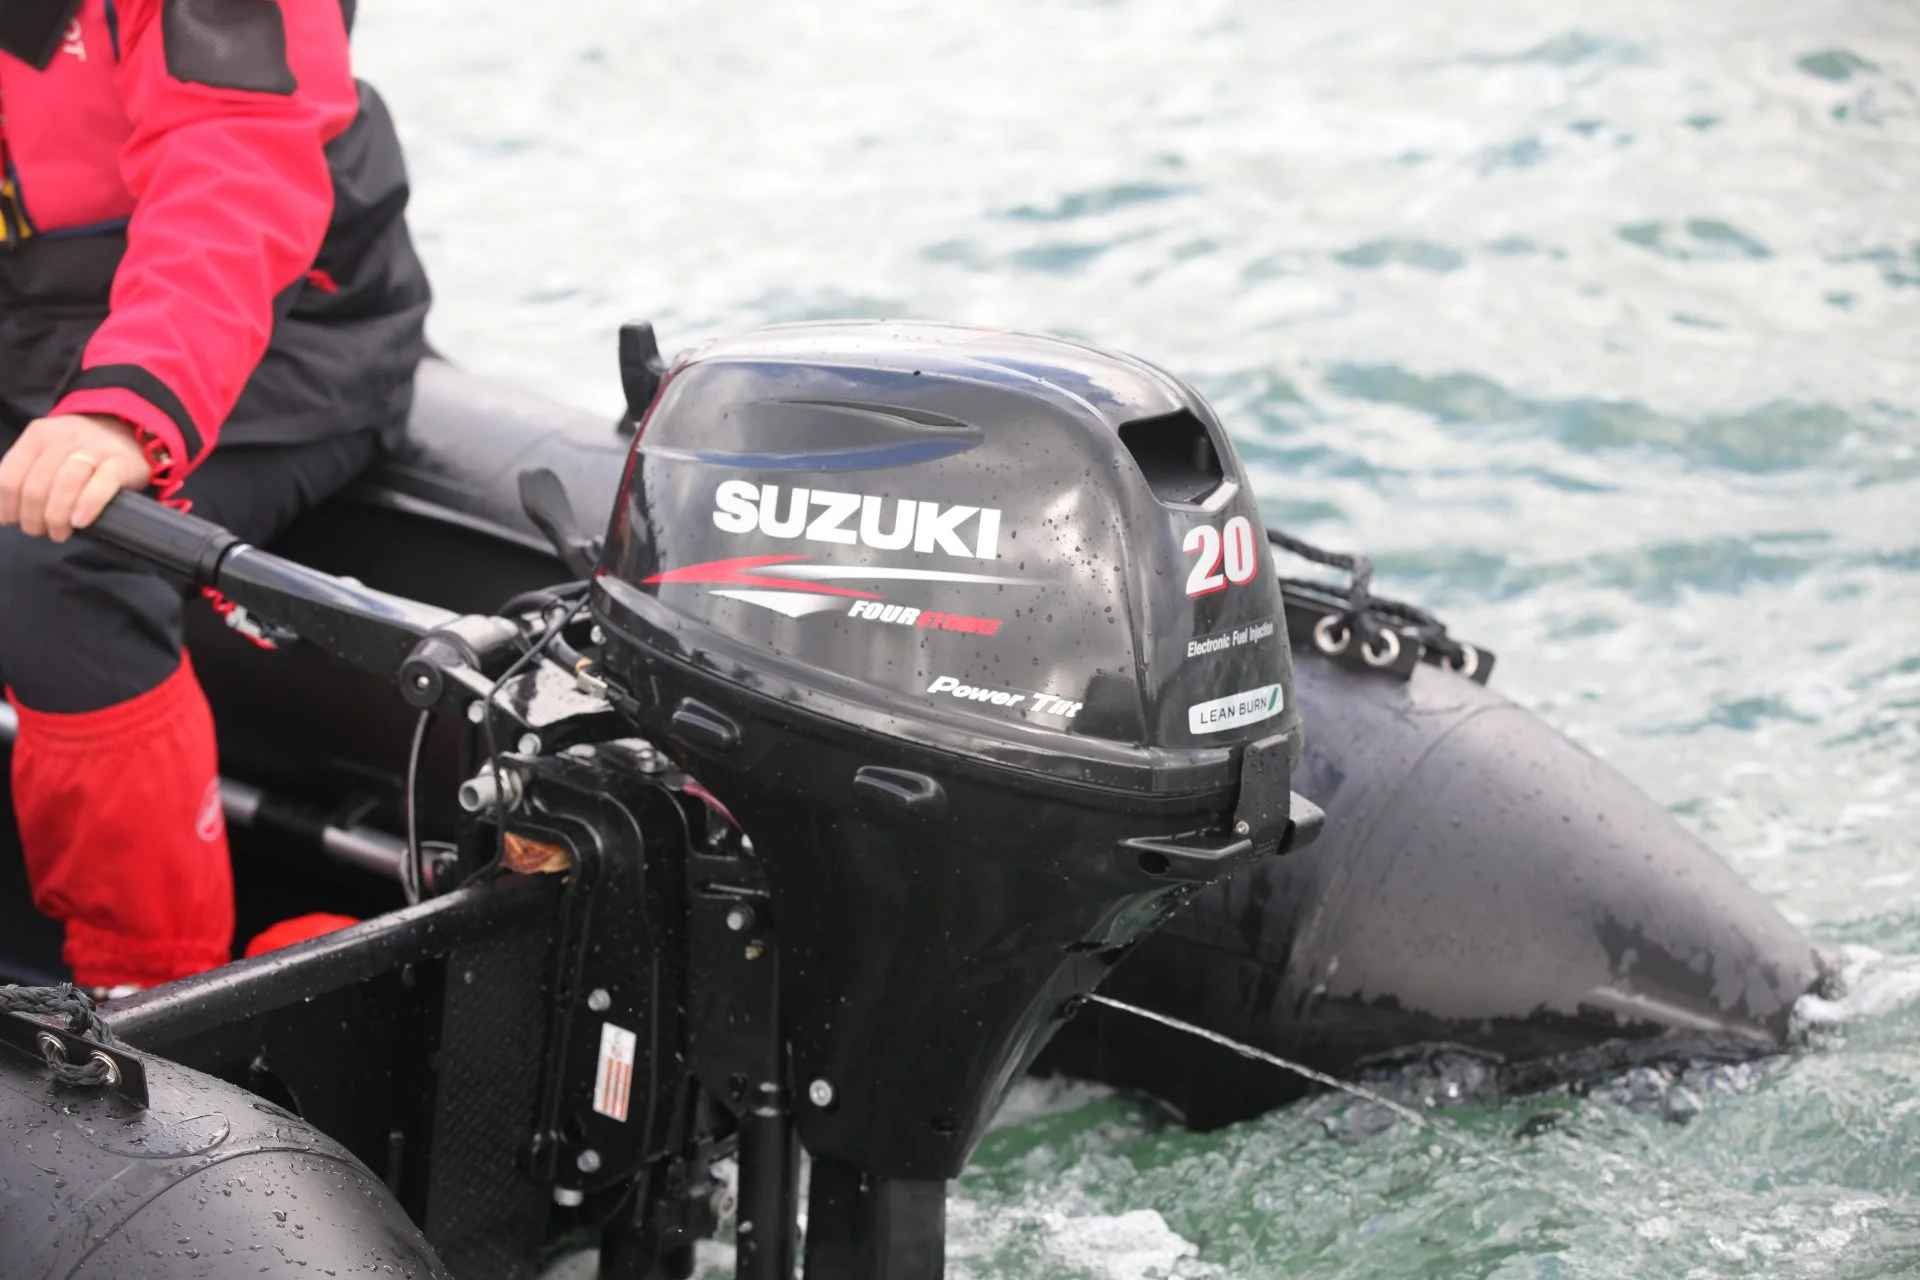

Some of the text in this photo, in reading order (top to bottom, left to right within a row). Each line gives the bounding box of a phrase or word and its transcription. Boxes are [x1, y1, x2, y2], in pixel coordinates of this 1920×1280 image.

[713, 480, 1001, 560] SUZUKI
[1183, 516, 1258, 597] 20
[1188, 621, 1273, 657] Electronic Fuel Injection
[927, 675, 1083, 717] Power Tilt
[1200, 697, 1267, 724] LEAN BURN
